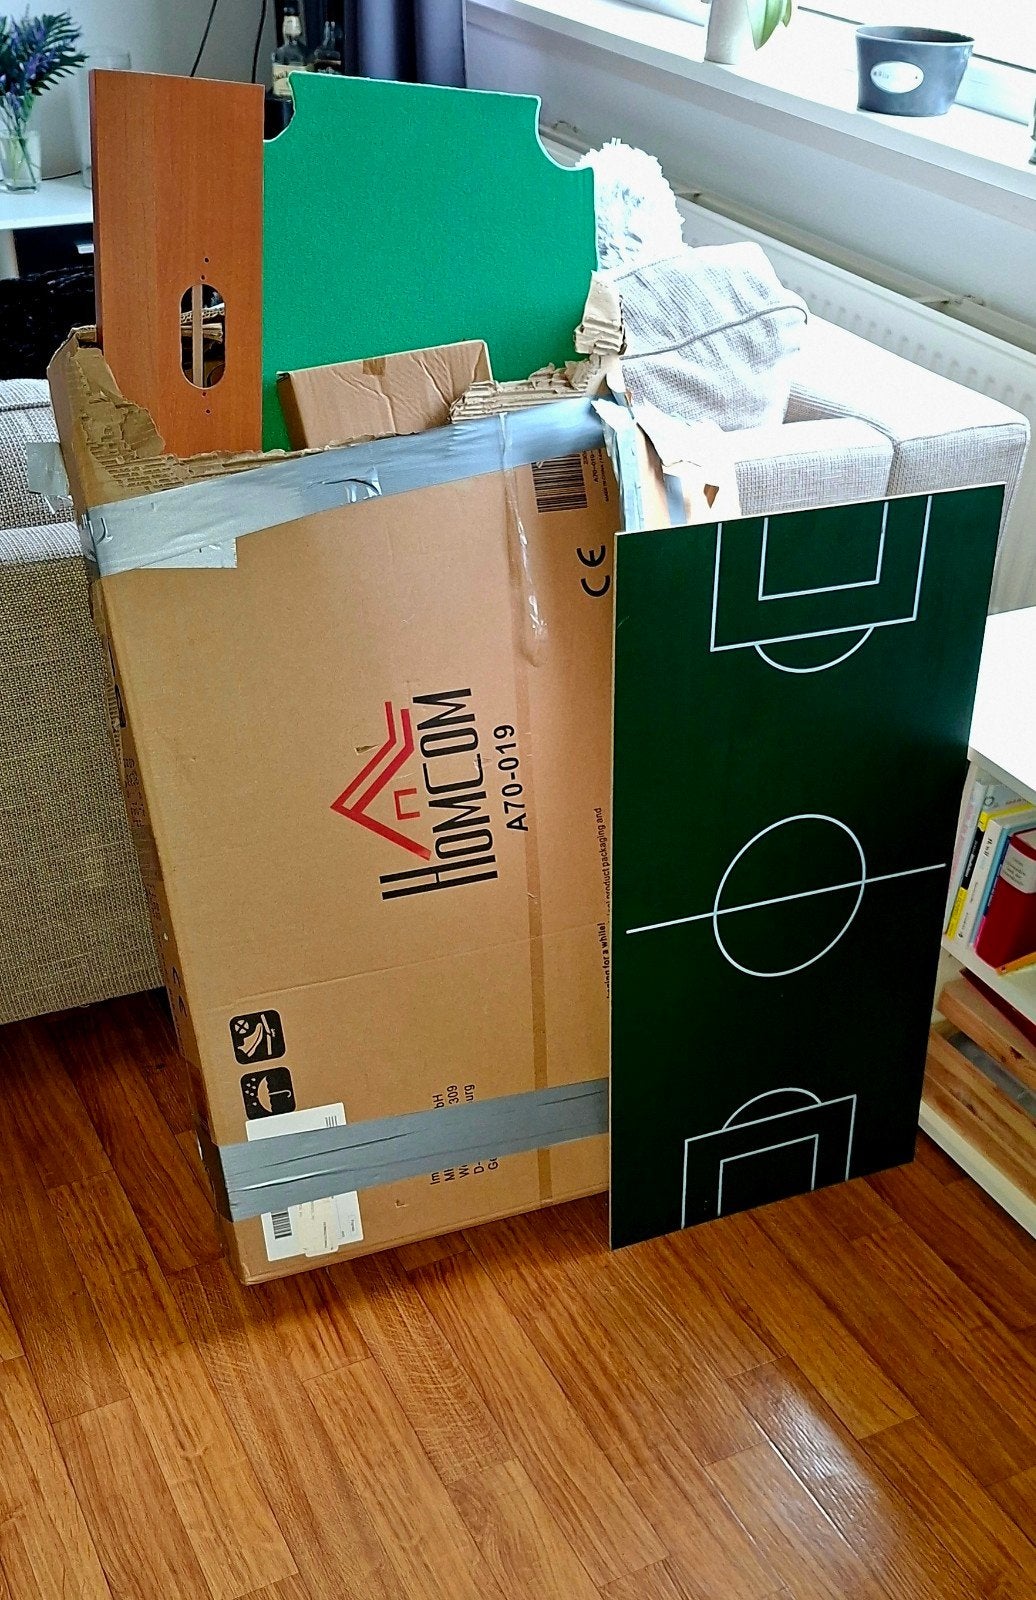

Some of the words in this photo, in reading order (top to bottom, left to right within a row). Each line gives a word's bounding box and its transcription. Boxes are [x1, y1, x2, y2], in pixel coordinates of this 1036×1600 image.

[493, 724, 529, 832] A70-019
[379, 688, 498, 900] HOMCOM
[594, 807, 604, 824] and
[597, 824, 611, 869] packaging
[597, 922, 608, 949] while!
[602, 956, 610, 969] for
[446, 1085, 460, 1105] 309
